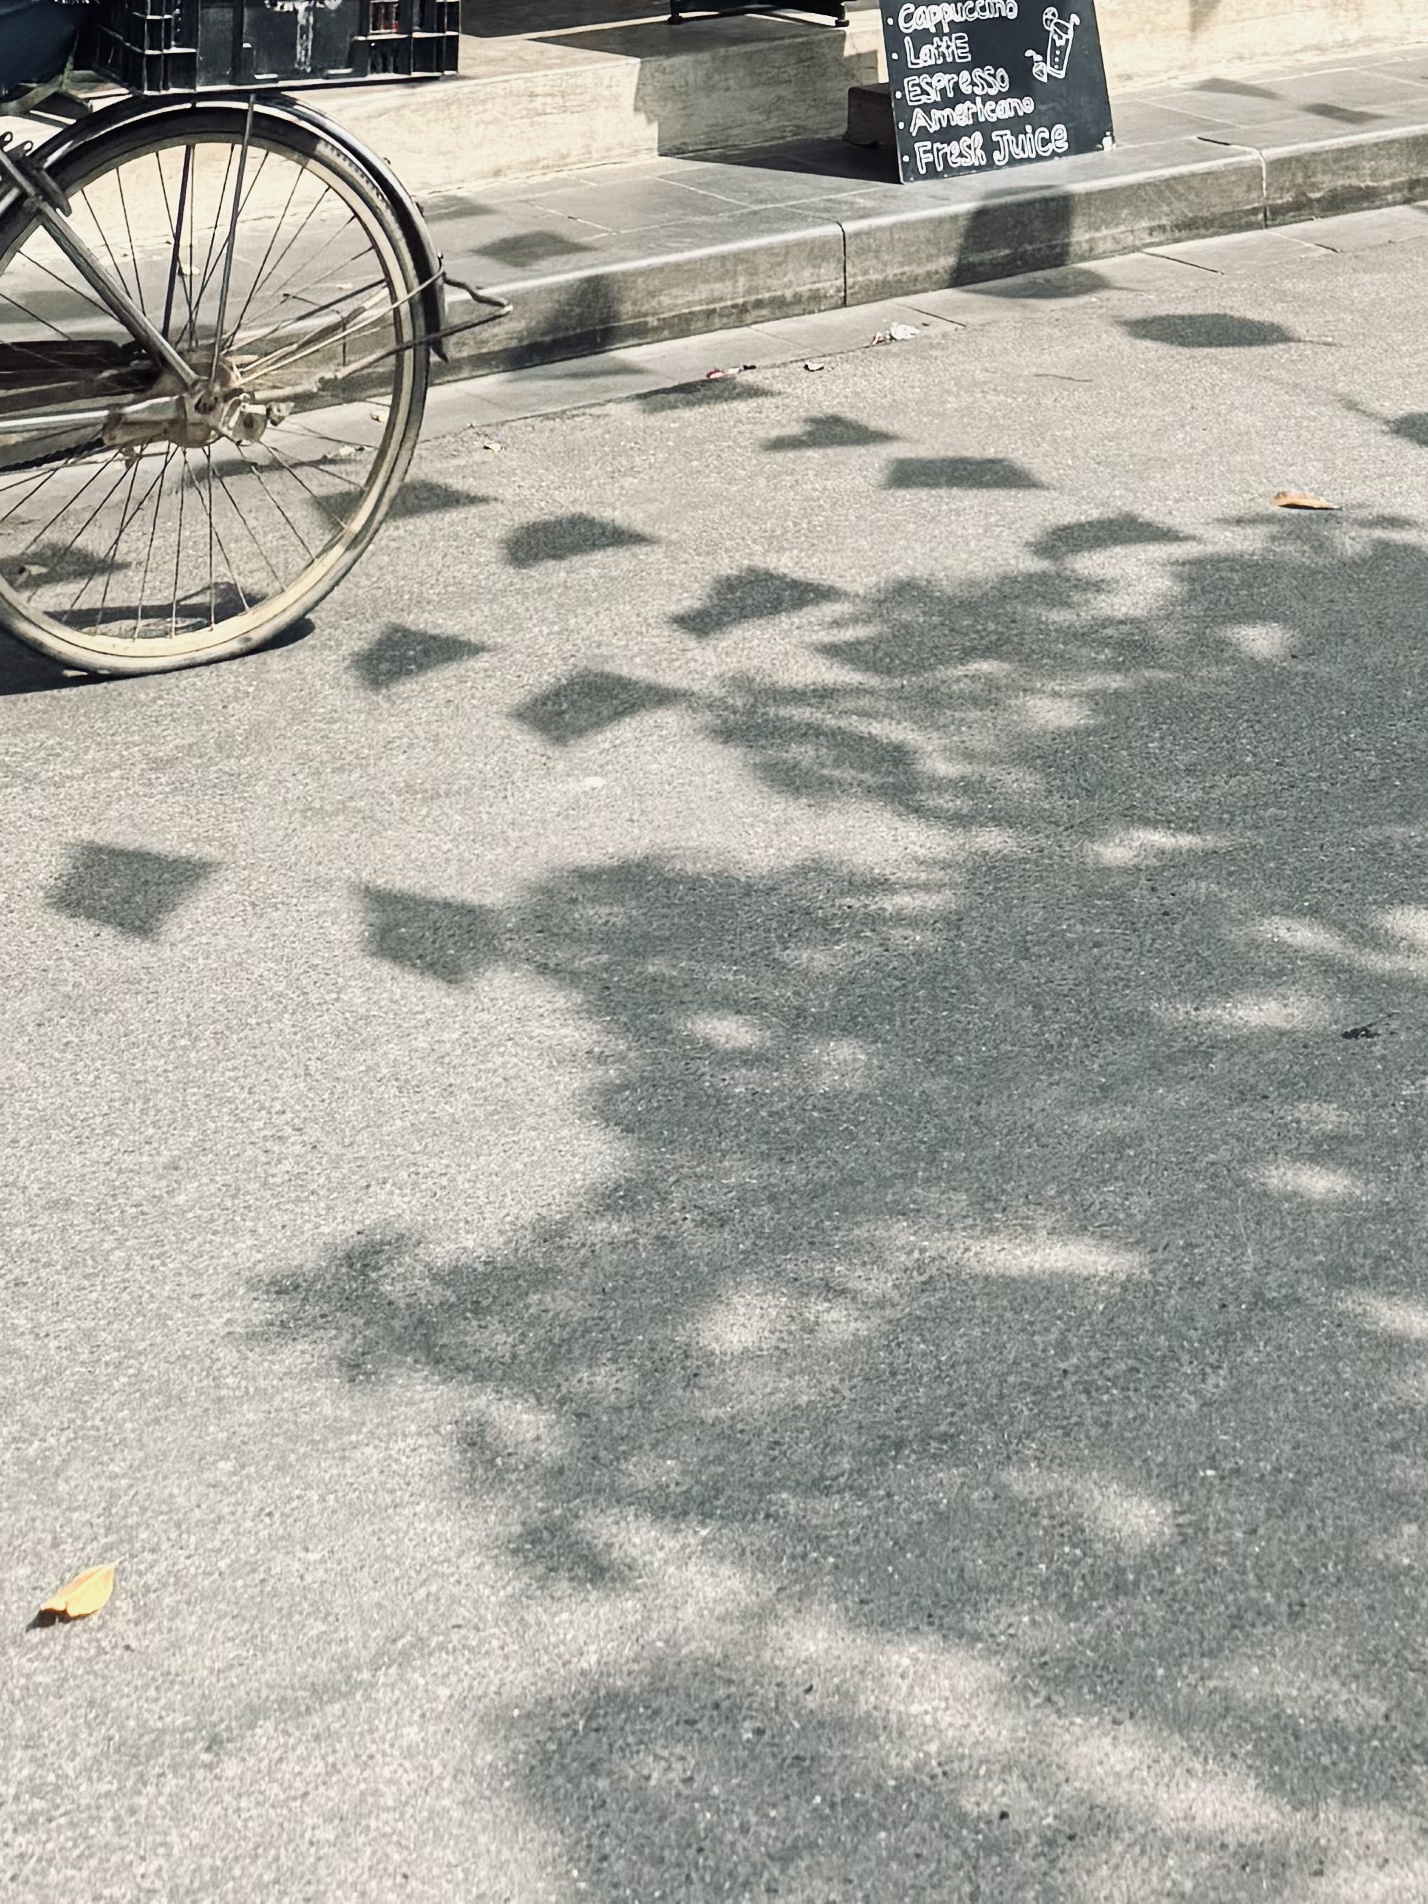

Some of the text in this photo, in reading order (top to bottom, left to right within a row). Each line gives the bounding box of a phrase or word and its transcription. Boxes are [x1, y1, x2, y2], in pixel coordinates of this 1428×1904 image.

[909, 95, 1036, 137] Americano
[914, 123, 1070, 175] Fresh Juice
